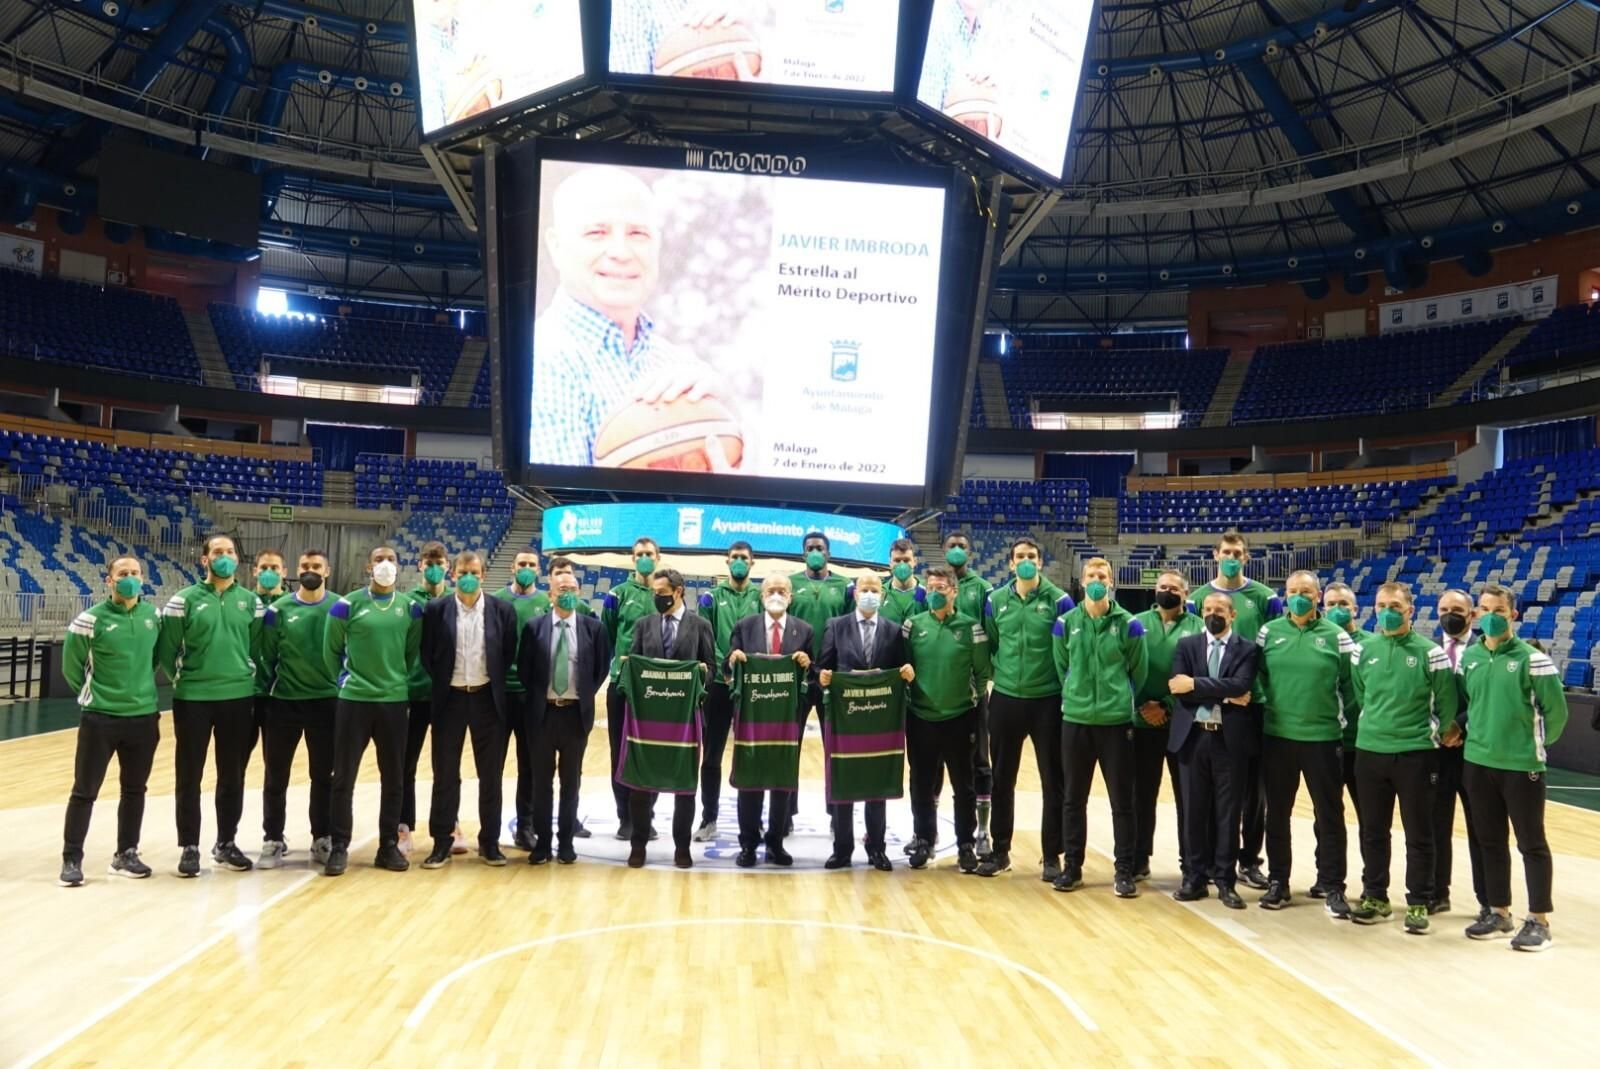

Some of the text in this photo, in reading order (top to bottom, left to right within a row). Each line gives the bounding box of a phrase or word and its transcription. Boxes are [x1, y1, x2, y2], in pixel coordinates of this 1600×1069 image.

[708, 151, 807, 175] MONDO
[778, 233, 930, 257] JAVIER IMBRODA
[778, 262, 858, 280] Estrella al
[836, 287, 918, 305] Deportivo
[772, 457, 887, 474] 7 de Enero de 2022
[711, 516, 804, 537] Ayuntamiento
[751, 673, 760, 683] DE
[761, 673, 771, 683] LA
[772, 672, 794, 683] TORRE
